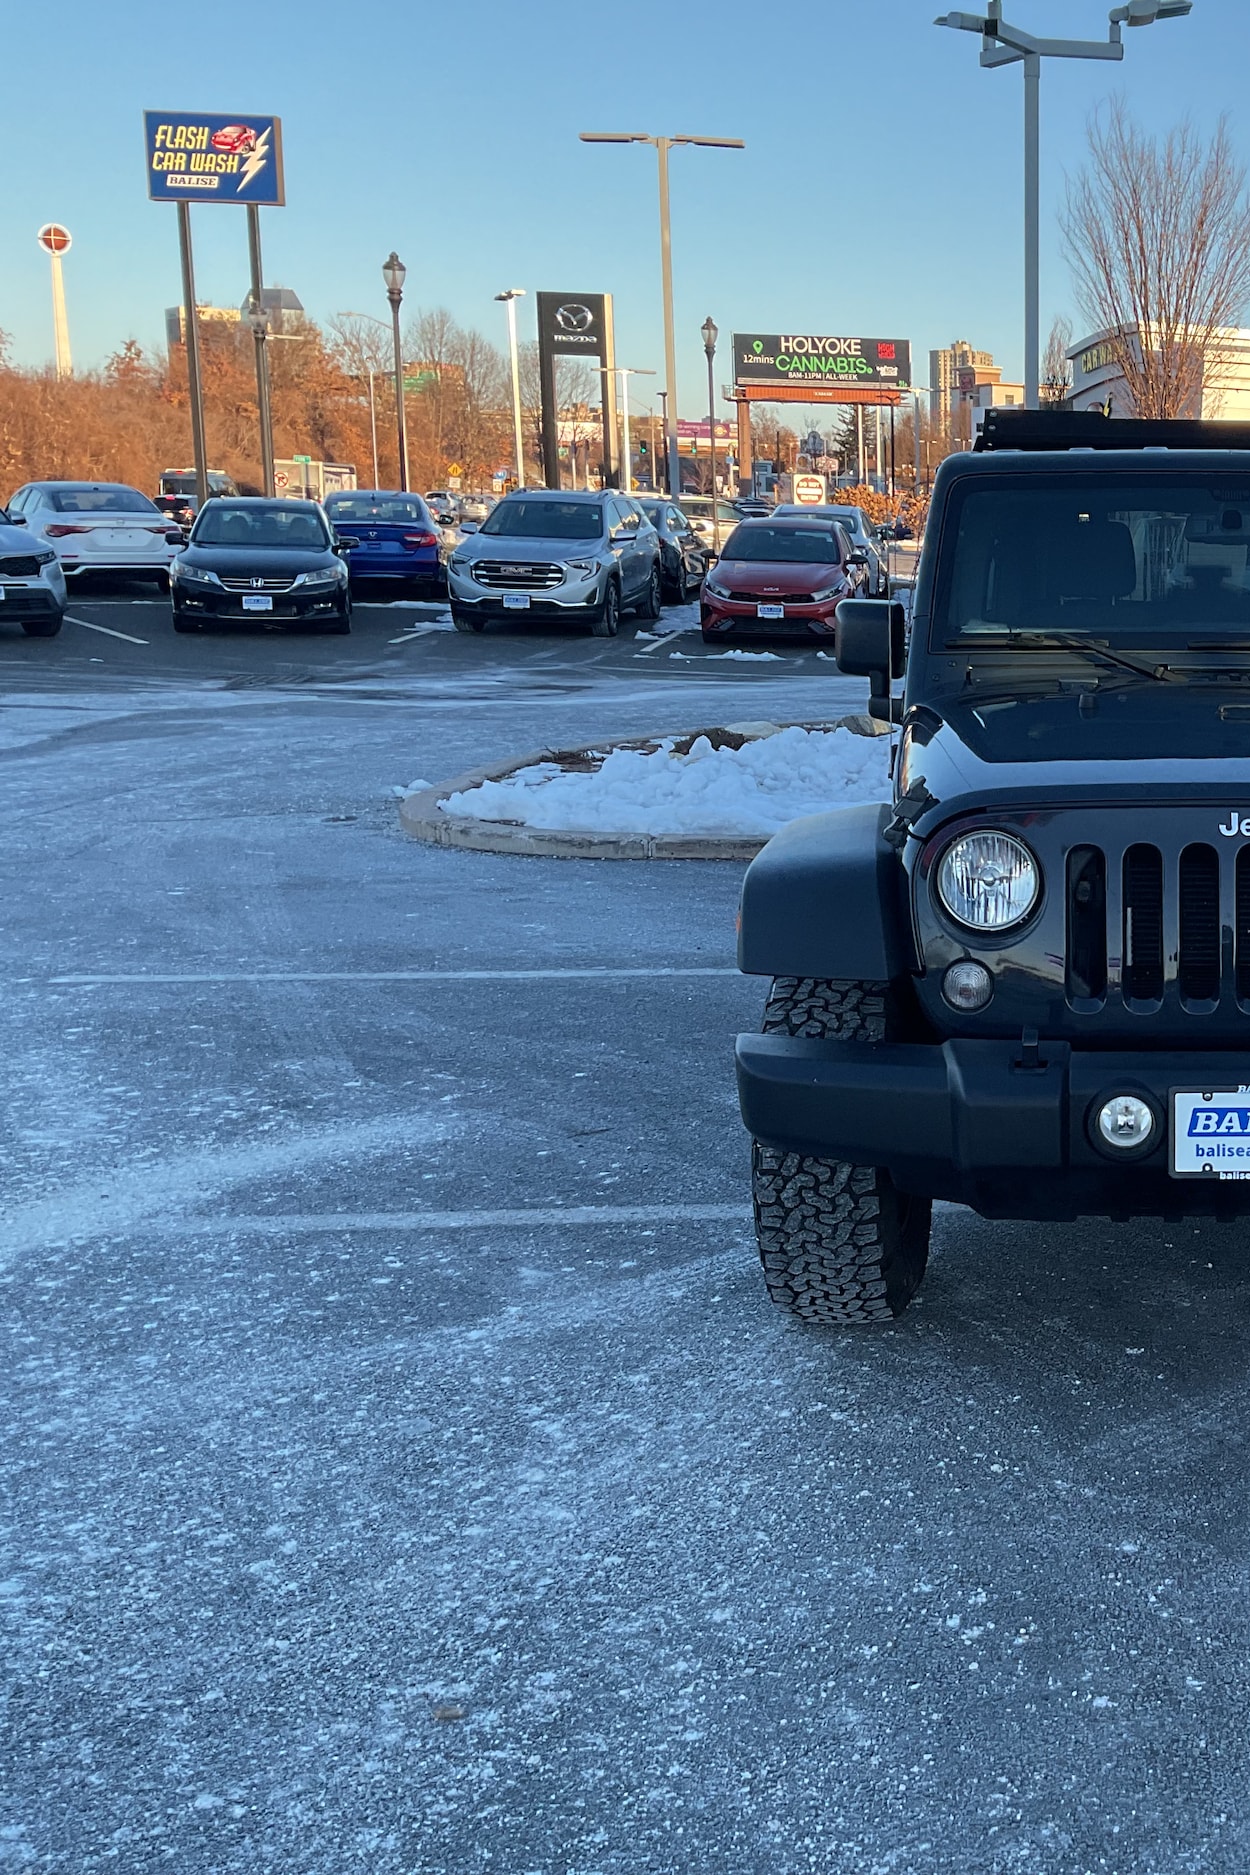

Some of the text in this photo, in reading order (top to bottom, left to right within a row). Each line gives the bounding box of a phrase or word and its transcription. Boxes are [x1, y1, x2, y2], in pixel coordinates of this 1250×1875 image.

[155, 124, 209, 150] FLASH
[152, 150, 239, 173] CAR WASH
[169, 176, 216, 186] BALISE
[780, 336, 862, 356] HOLYOKE
[743, 354, 775, 365] 12mins
[1081, 349, 1098, 374] CAR
[788, 371, 858, 381] 8AM-11PM ALL-WEEK
[500, 566, 533, 576] GMC
